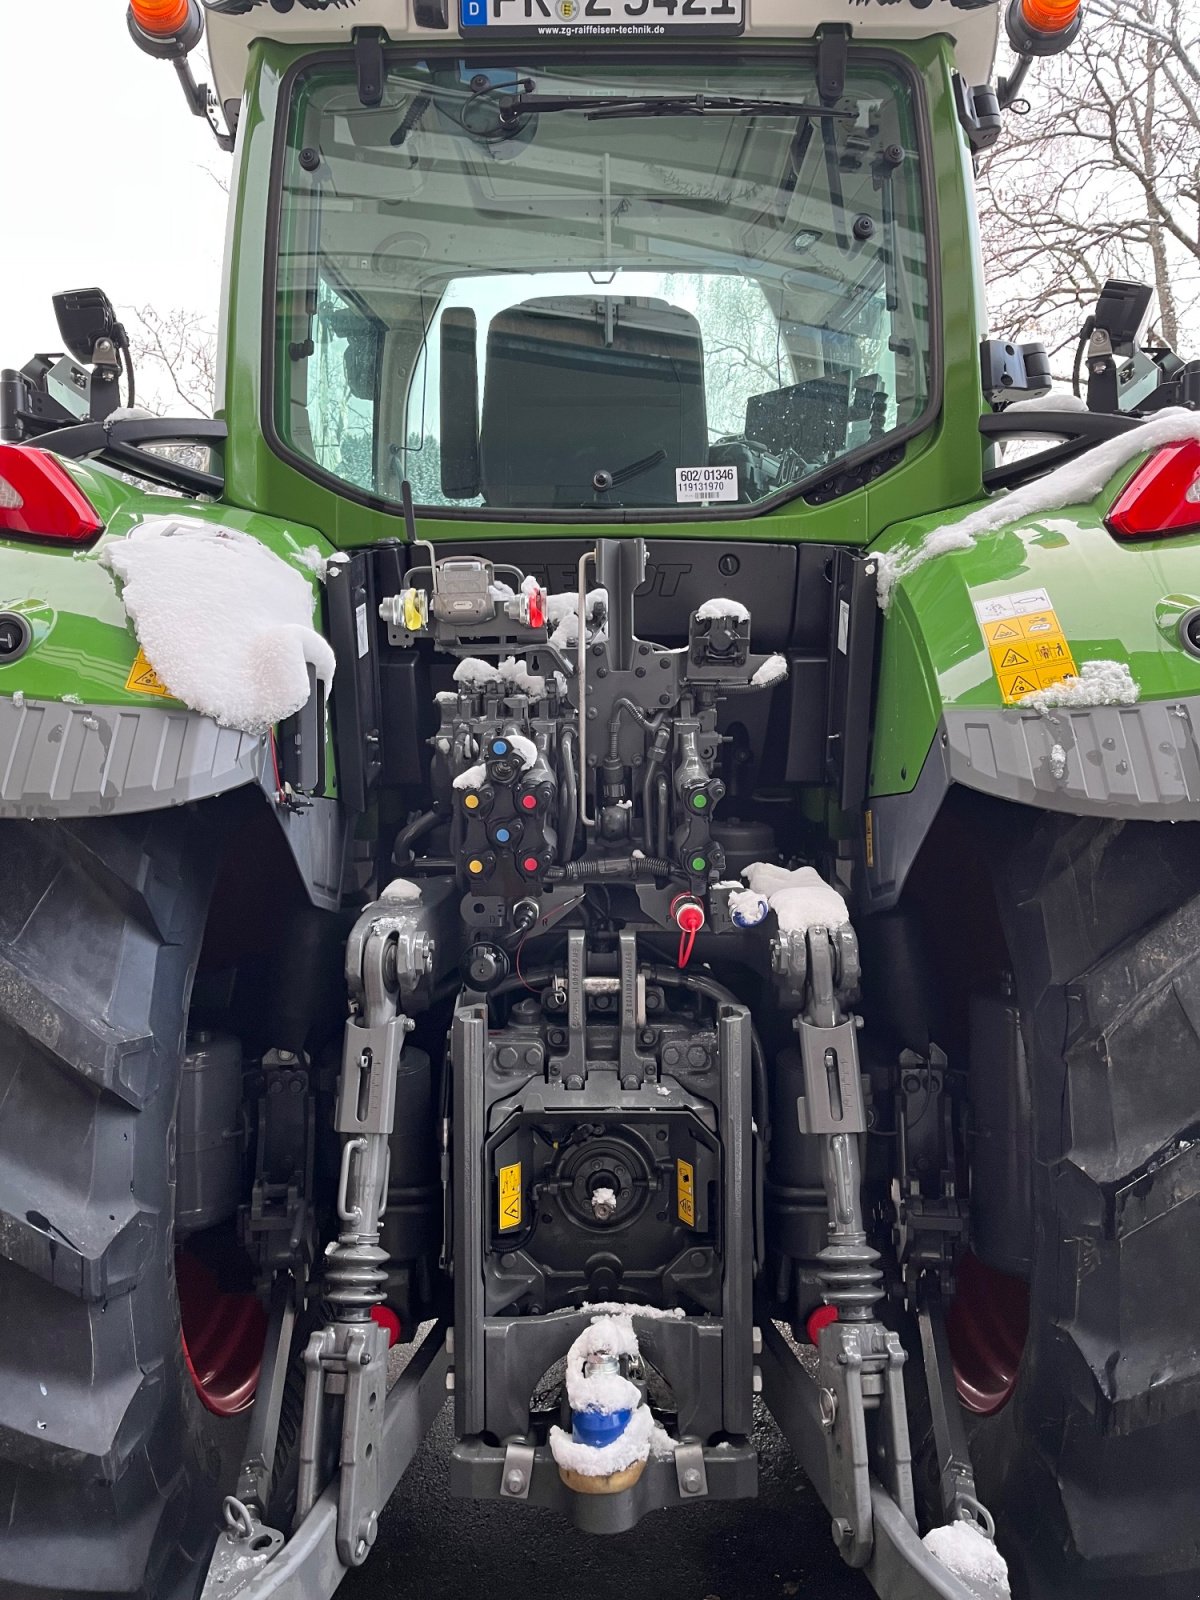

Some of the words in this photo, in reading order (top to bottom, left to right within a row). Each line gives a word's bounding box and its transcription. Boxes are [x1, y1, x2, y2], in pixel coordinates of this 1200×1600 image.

[469, 2, 479, 16] D
[538, 25, 665, 36] www.zg-raiffeisen-technik.de
[677, 482, 724, 492] 119131970
